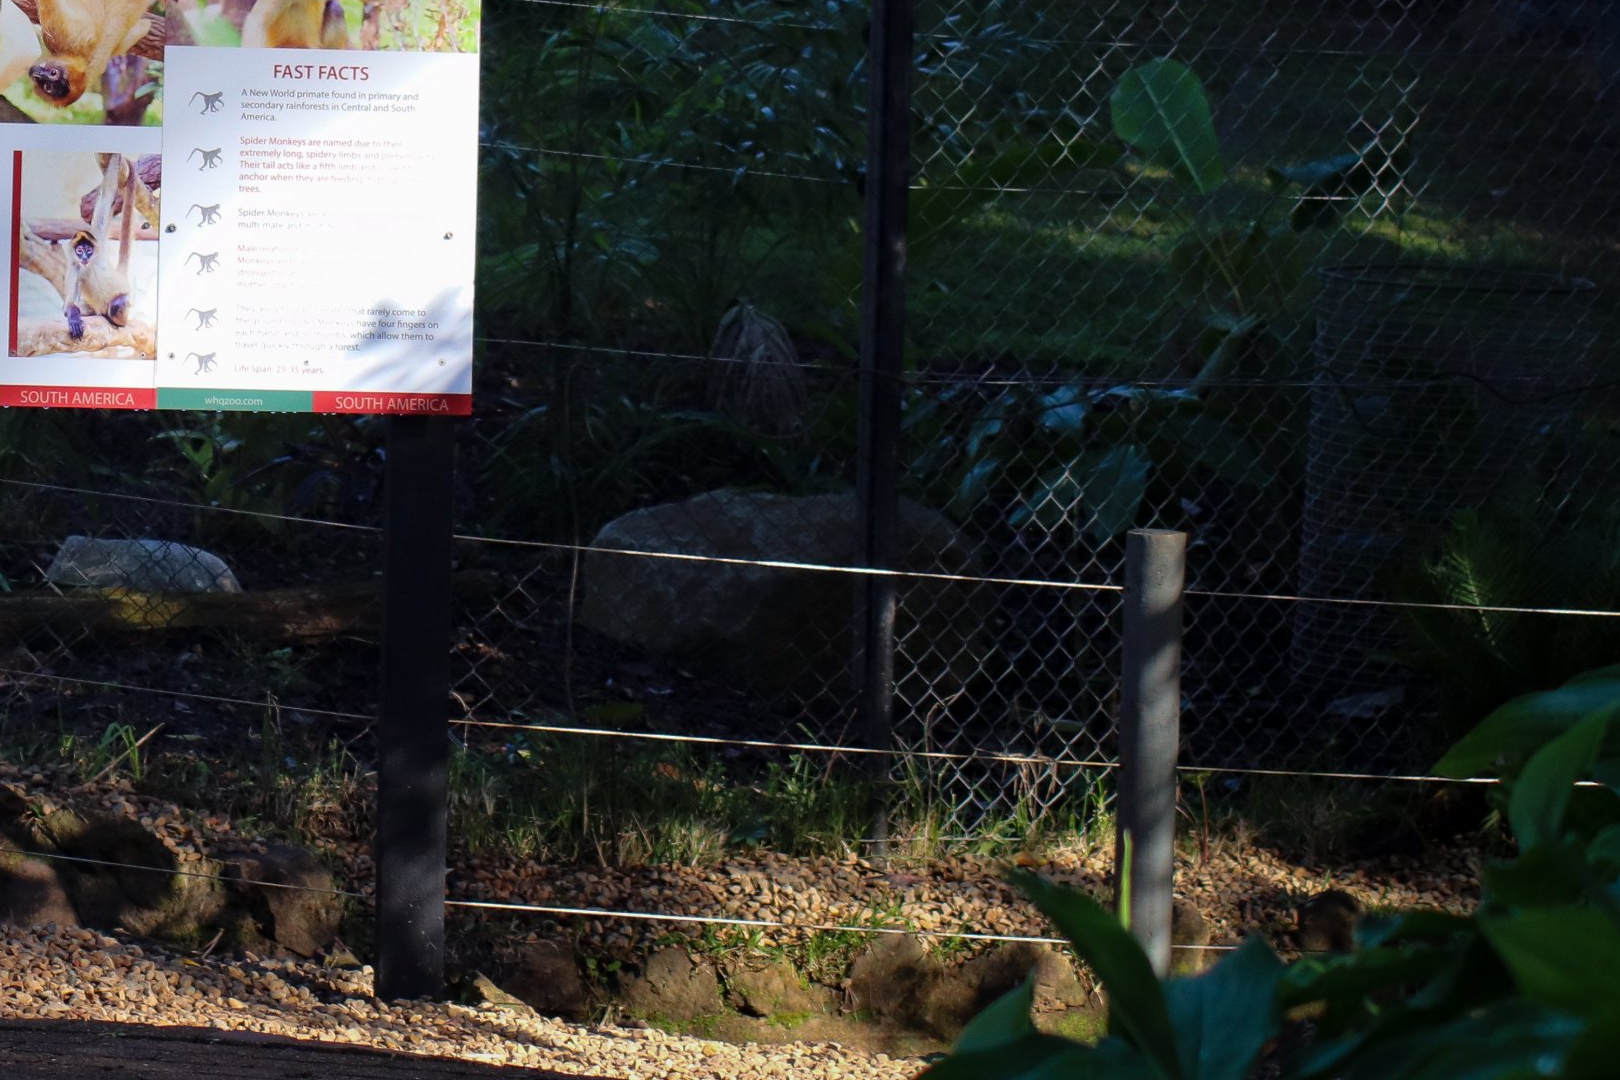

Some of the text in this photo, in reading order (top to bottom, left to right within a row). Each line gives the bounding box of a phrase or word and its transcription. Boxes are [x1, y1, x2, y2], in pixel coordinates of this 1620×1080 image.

[274, 64, 369, 80] FAST FACTS
[242, 89, 419, 101] A New World primate found in primary and
[241, 102, 283, 111] secondary
[286, 102, 329, 110] rainforests
[341, 103, 371, 111] Central
[372, 103, 389, 112] and
[391, 104, 416, 113] South
[241, 113, 276, 121] America.
[240, 136, 267, 146] Spider
[269, 137, 305, 147] Monkeys
[239, 149, 281, 159] extremely
[282, 149, 304, 160] long,
[239, 160, 261, 169] Their
[262, 160, 276, 169] tail
[277, 162, 294, 170] acts
[238, 172, 268, 181] anchor
[237, 208, 265, 218] Spider
[367, 308, 390, 317] rarely
[356, 319, 378, 328] have
[378, 320, 395, 328] four
[397, 320, 426, 330] fingers
[350, 331, 375, 340] which
[377, 332, 399, 340] allow
[425, 333, 434, 341] to
[20, 391, 135, 406] SOUTH AMERICA
[205, 395, 263, 407] whqzoo.com
[336, 397, 449, 412] SOUTH AMERICA
